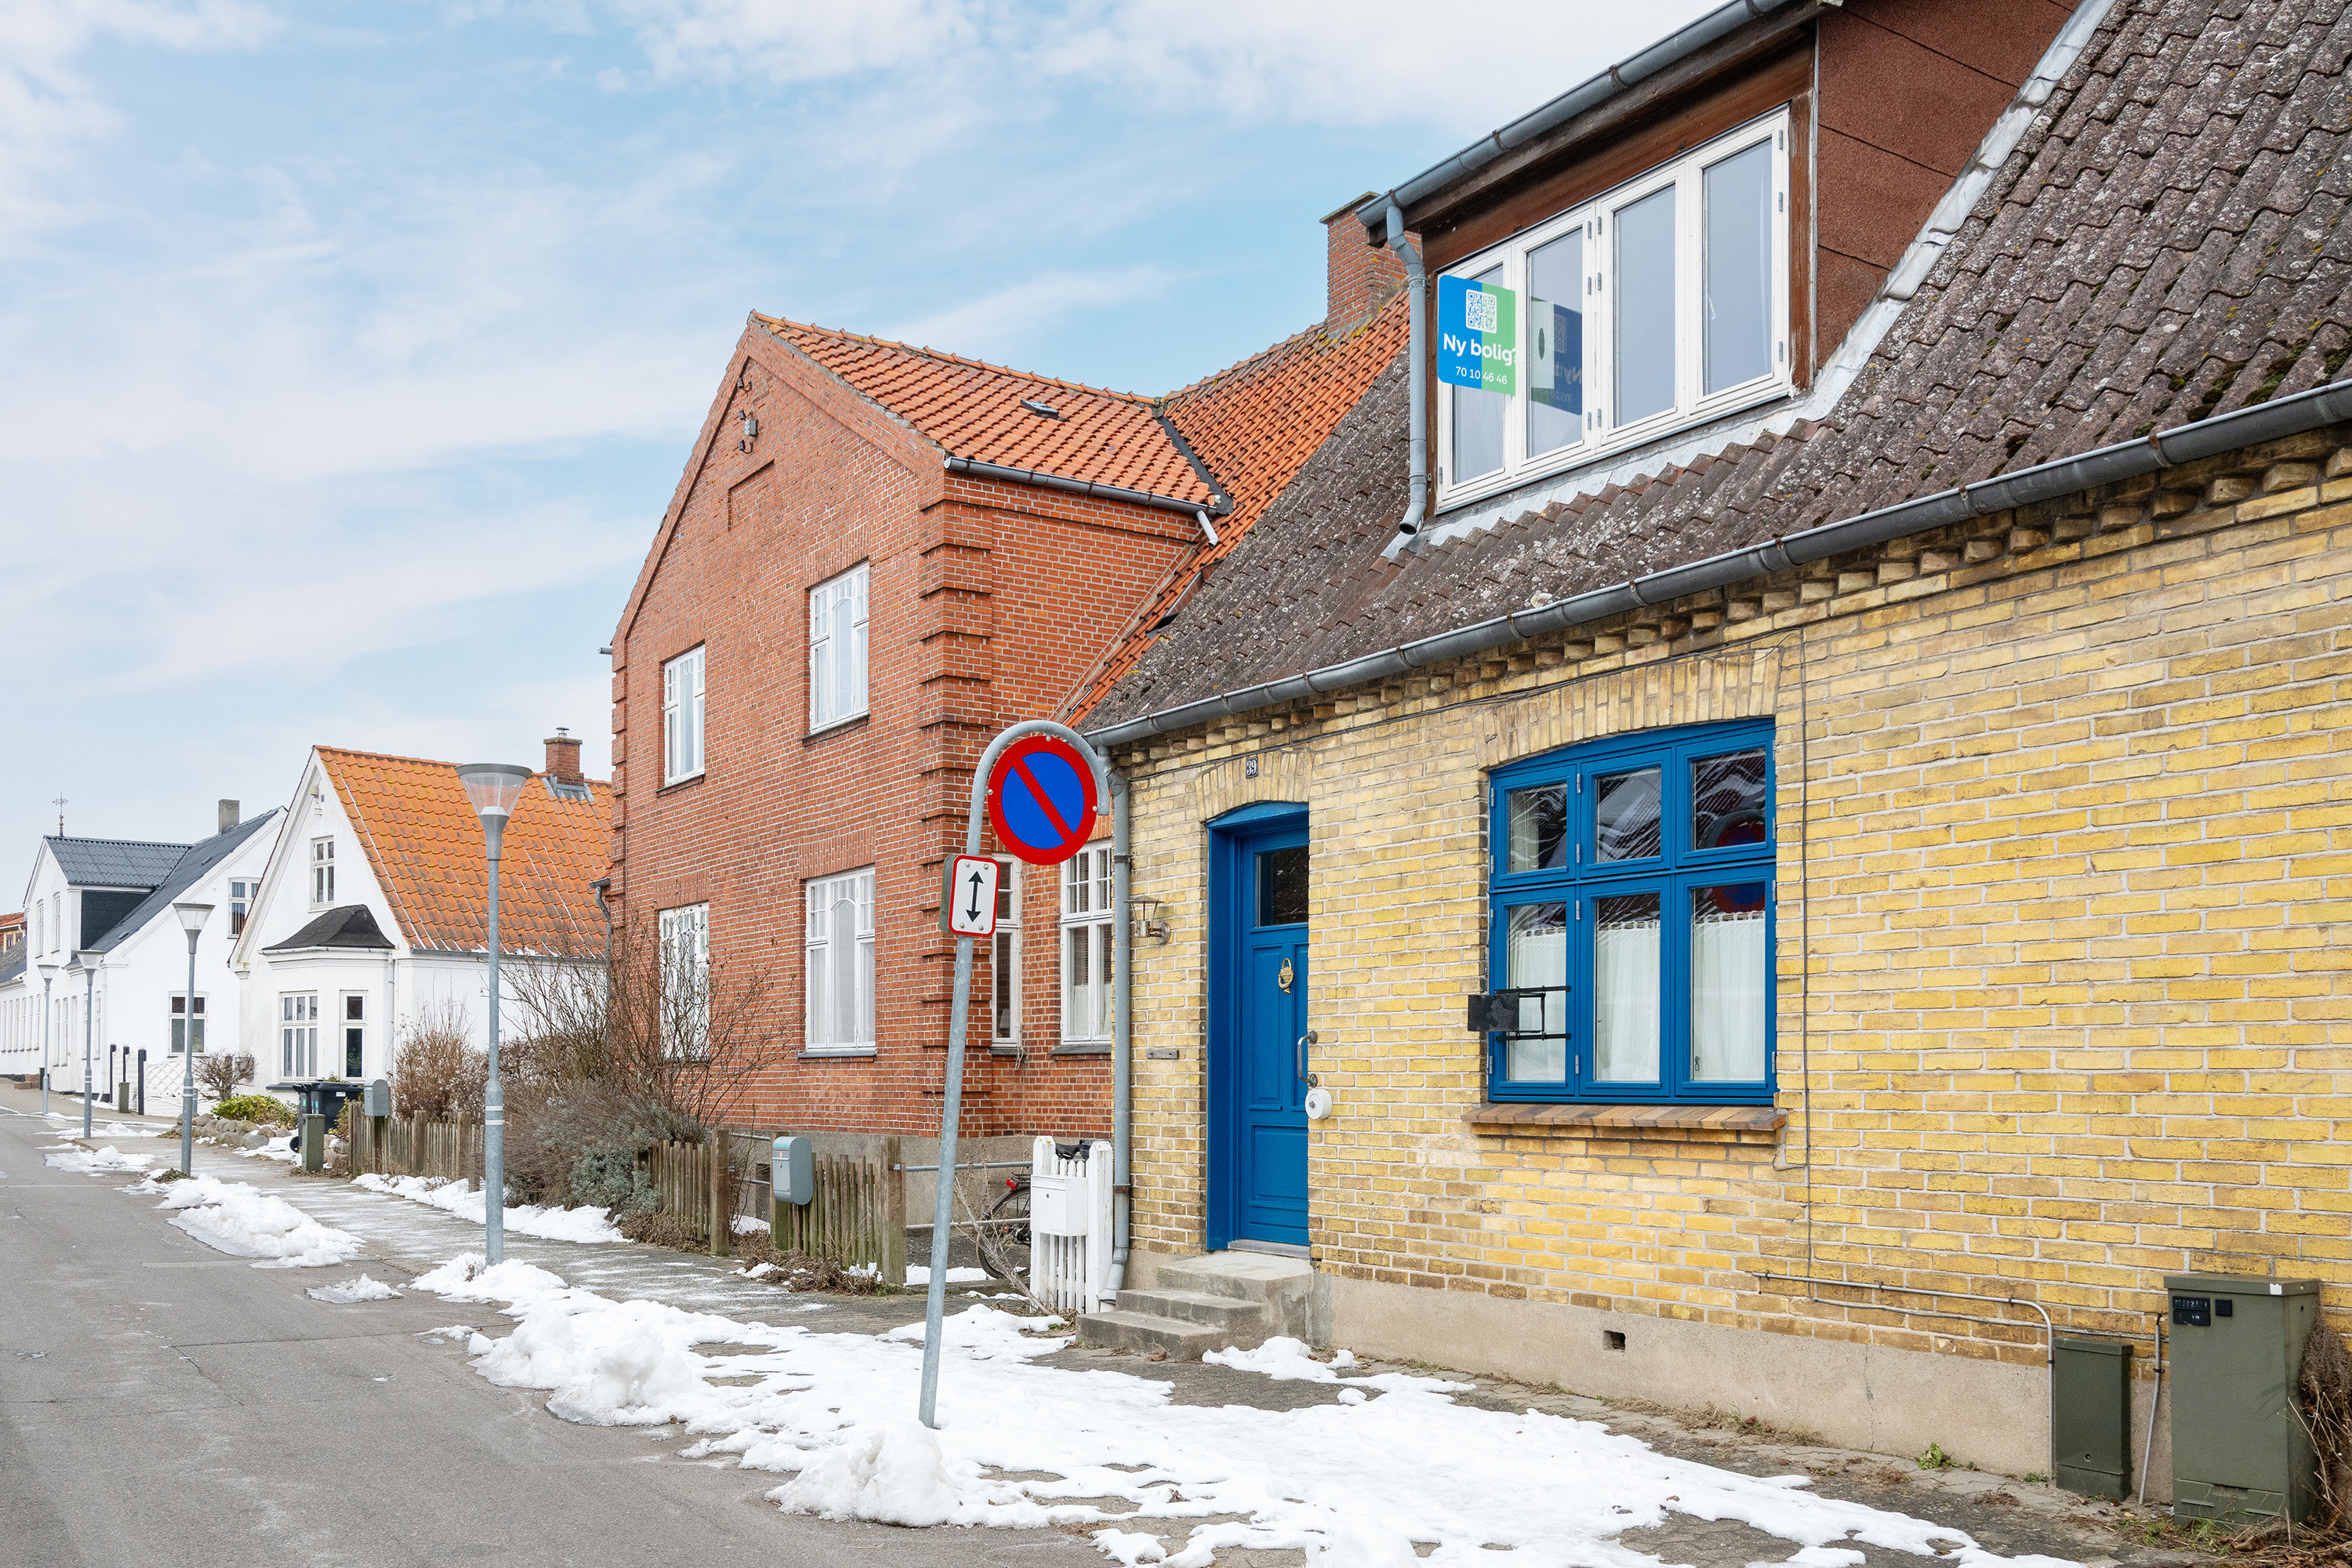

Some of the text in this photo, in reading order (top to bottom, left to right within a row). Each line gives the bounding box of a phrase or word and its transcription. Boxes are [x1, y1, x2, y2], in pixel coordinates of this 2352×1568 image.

[1443, 332, 1467, 357] Ny
[1455, 365, 1508, 385] 70 10 46 46
[1247, 759, 1257, 775] 39
